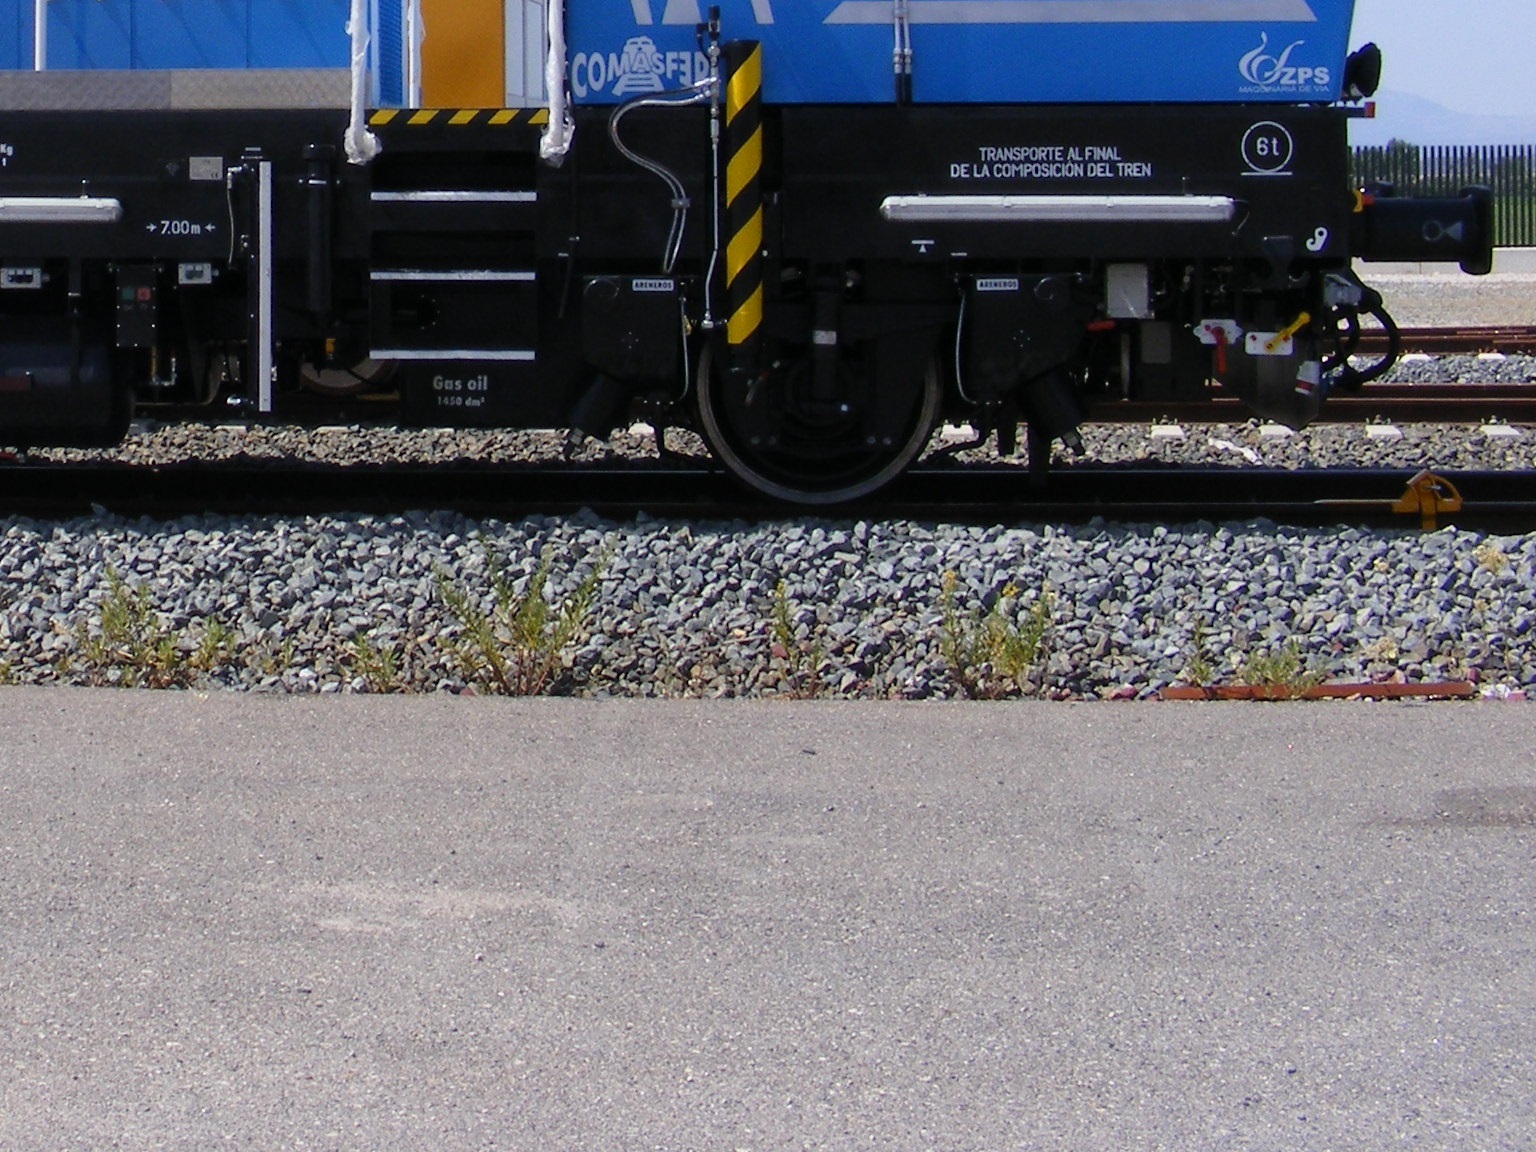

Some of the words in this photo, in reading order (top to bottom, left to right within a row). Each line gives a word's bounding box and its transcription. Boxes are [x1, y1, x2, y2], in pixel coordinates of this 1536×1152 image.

[1279, 67, 1330, 85] ZPS
[0, 144, 13, 156] Kg
[979, 147, 1064, 162] TRANSPORTE
[1067, 147, 1083, 161] AL
[1085, 147, 1122, 161] FINAL
[1256, 137, 1280, 156] 6t
[950, 163, 970, 178] DE
[973, 163, 990, 178] LA
[993, 160, 1084, 178] COMPOSICIÓN
[1087, 163, 1113, 177] DEL
[1116, 163, 1152, 177] TREN
[433, 375, 462, 390] Gas
[467, 374, 488, 390] oil
